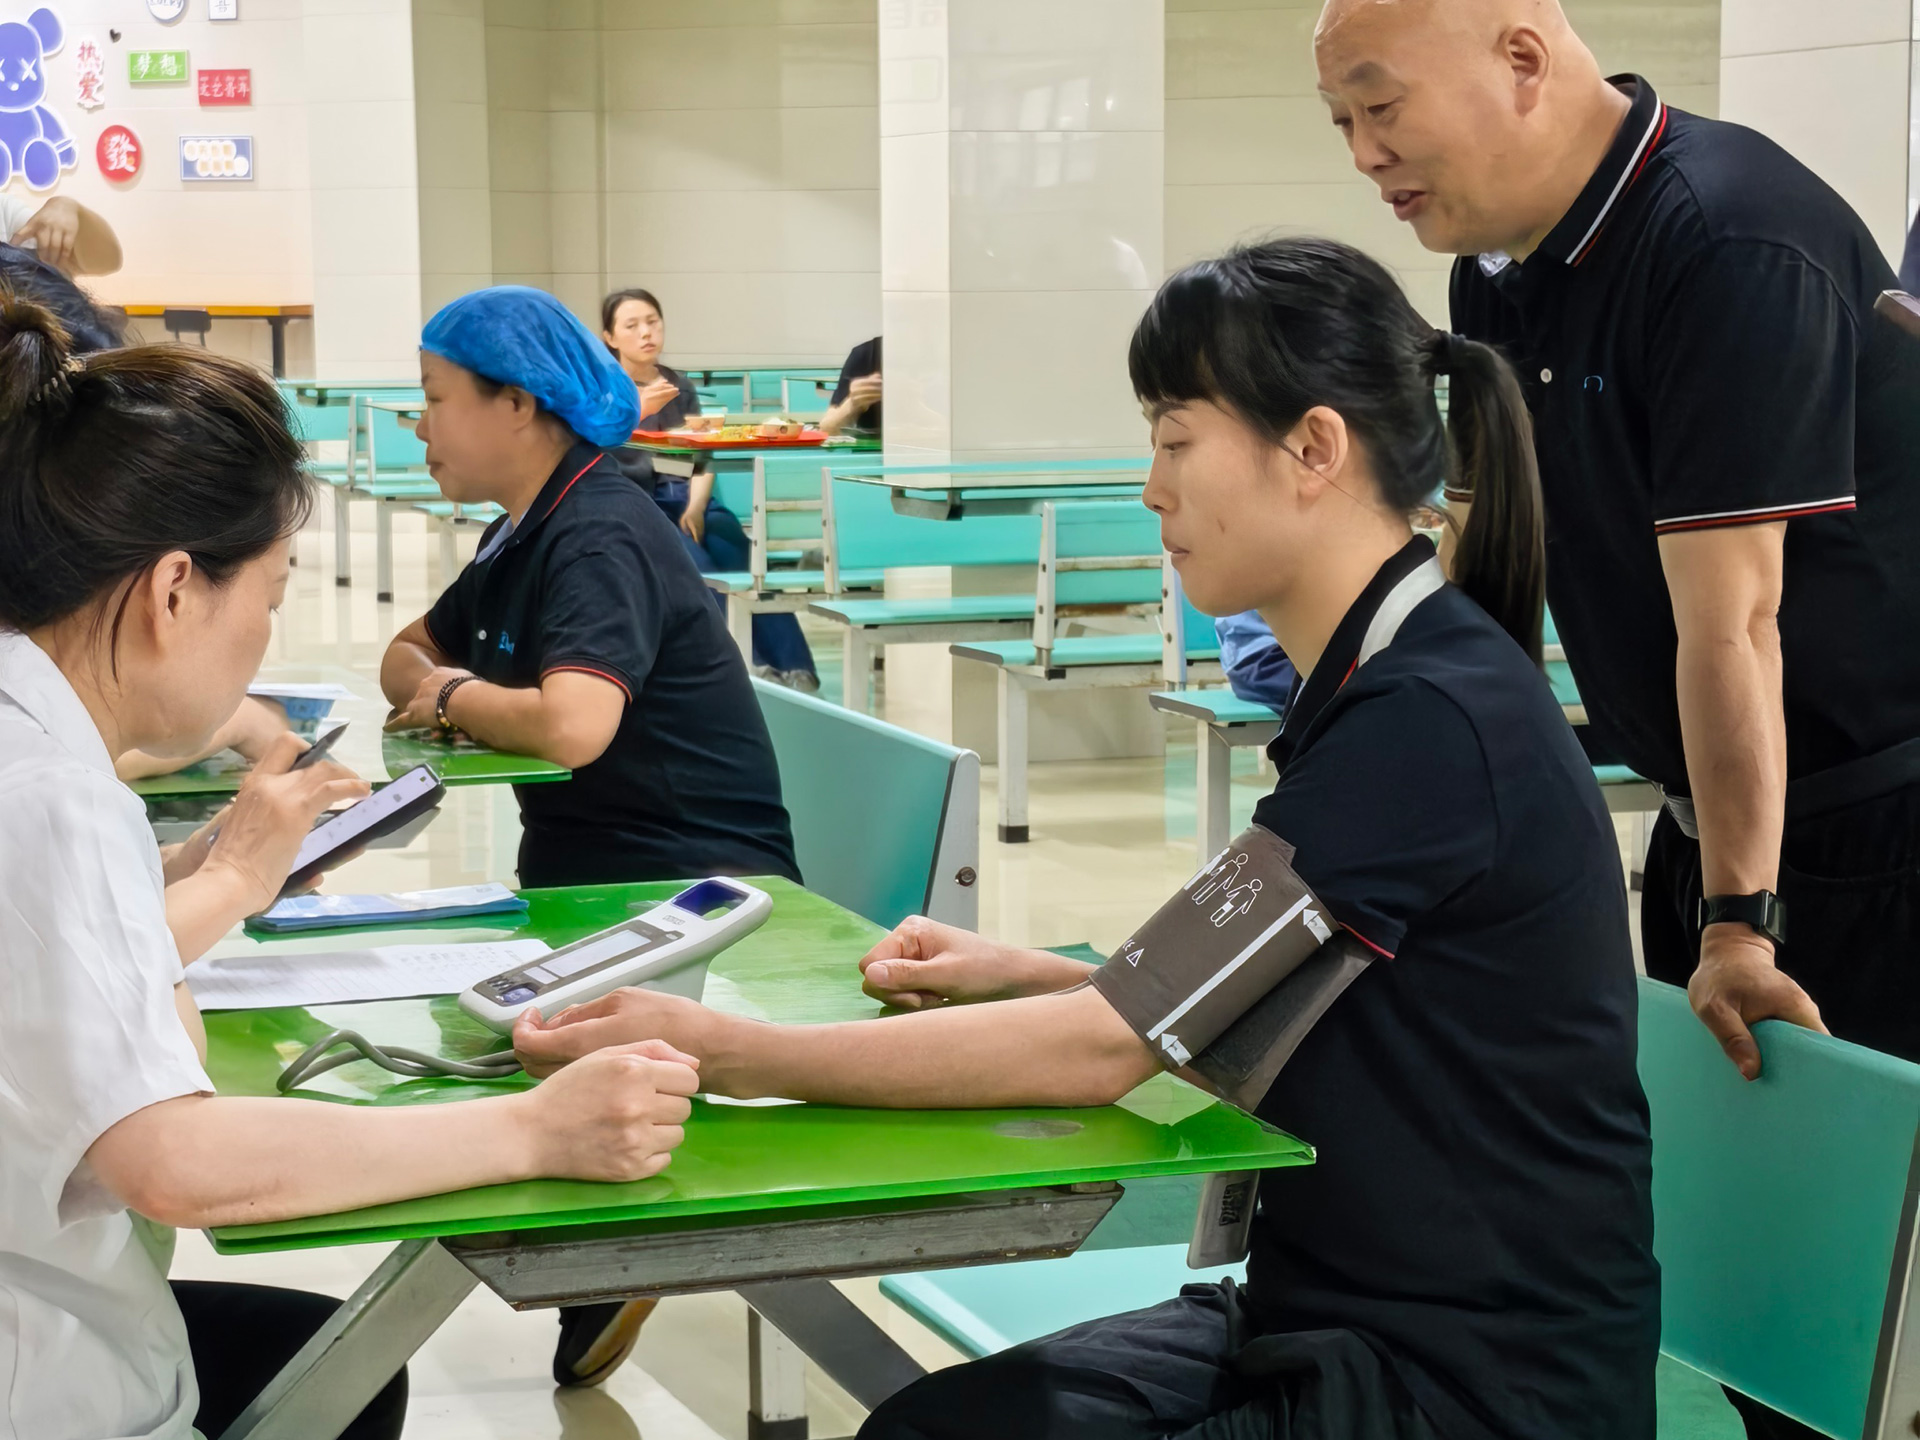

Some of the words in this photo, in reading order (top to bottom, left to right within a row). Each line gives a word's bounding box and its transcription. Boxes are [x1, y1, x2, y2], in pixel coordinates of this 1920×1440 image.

[137, 53, 178, 79] 梦想
[199, 79, 250, 98] 文艺青年
[106, 133, 137, 173] 發
